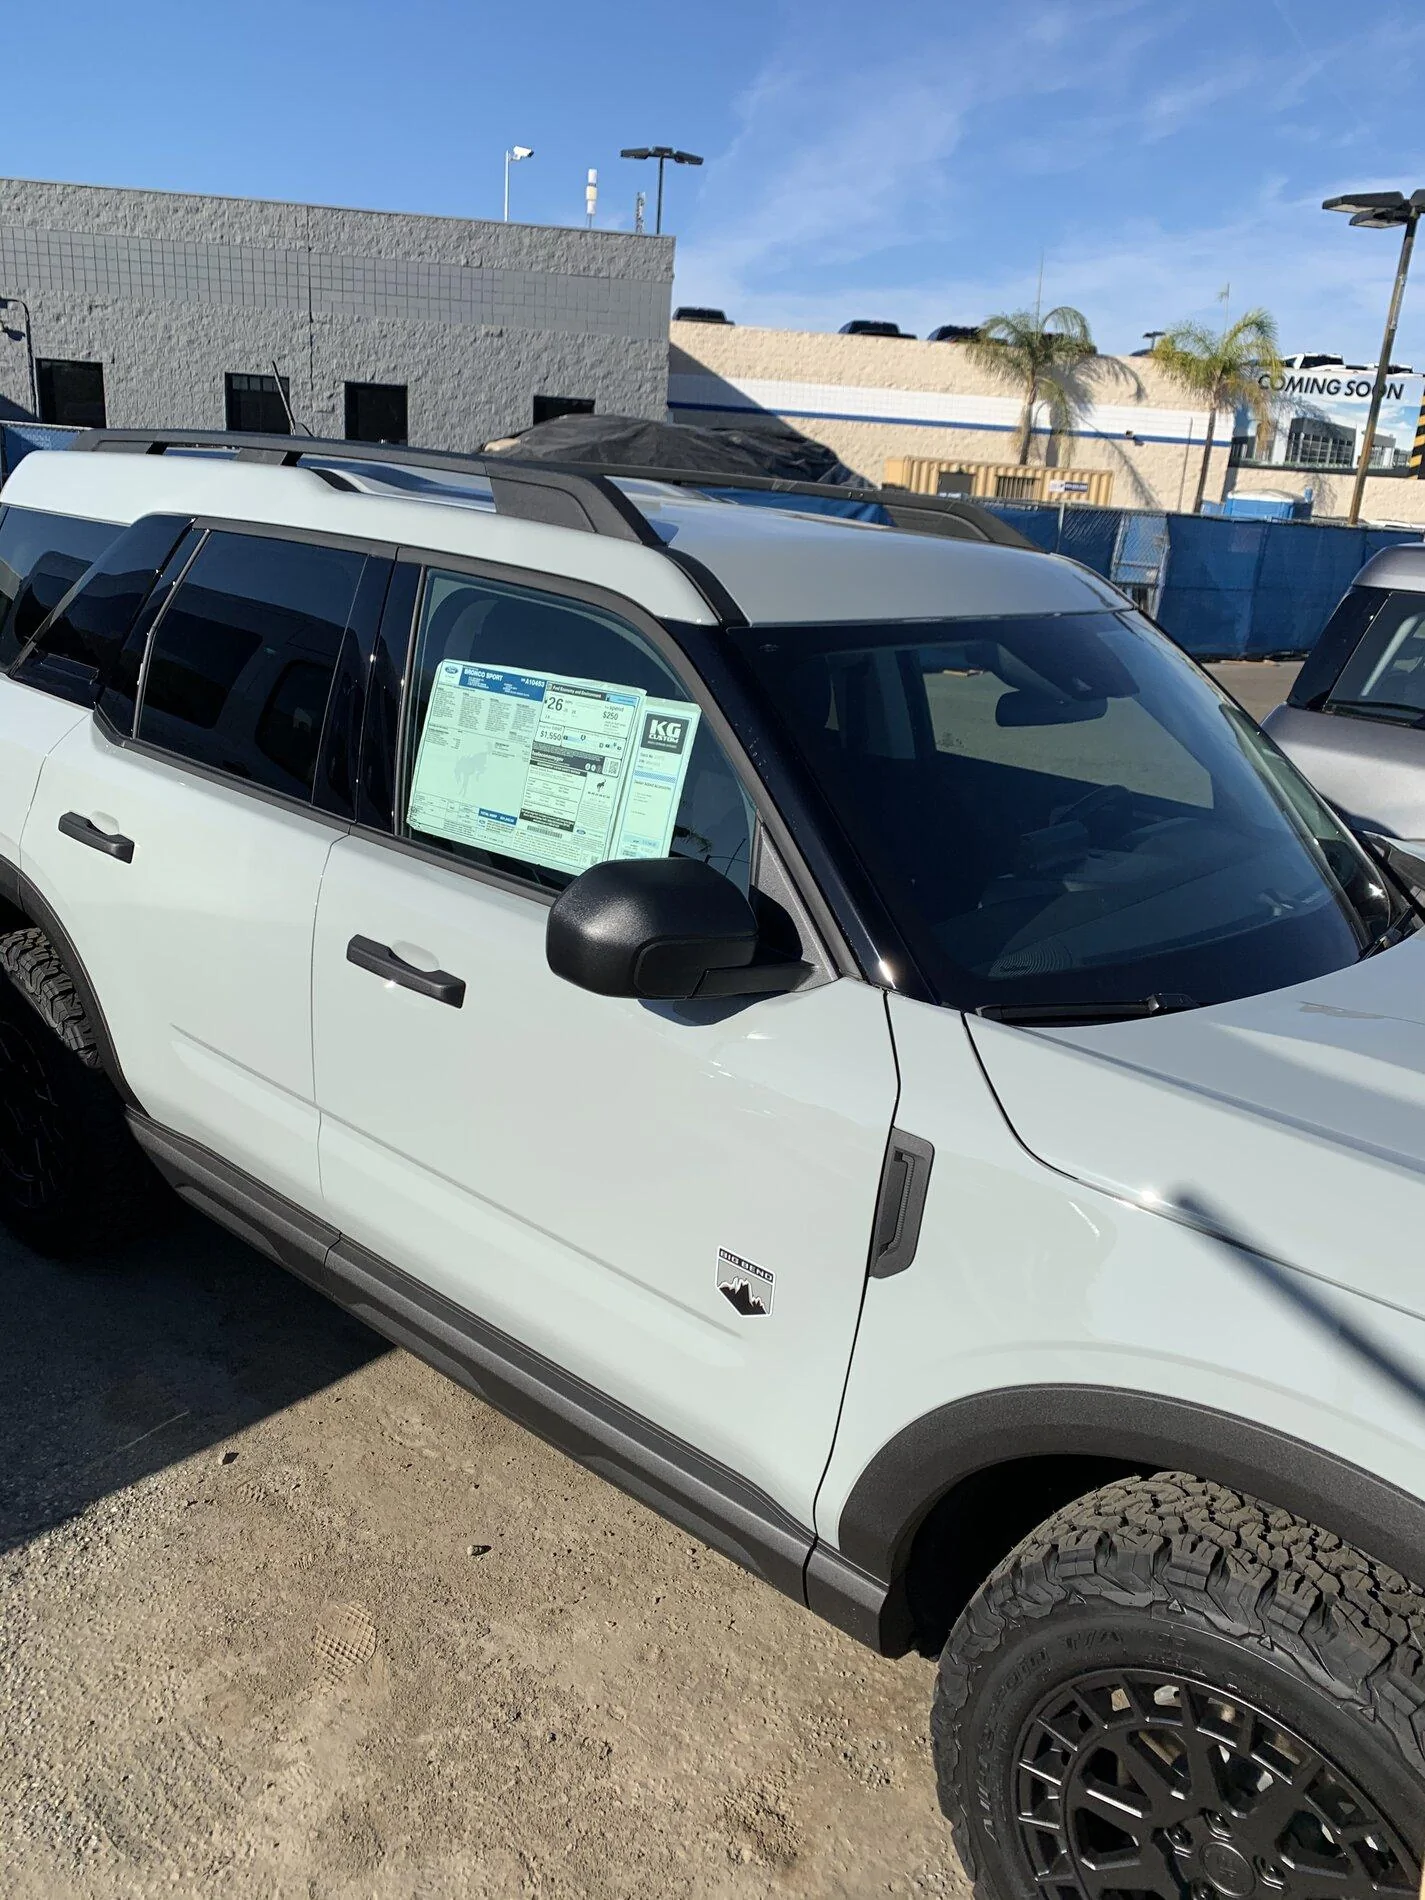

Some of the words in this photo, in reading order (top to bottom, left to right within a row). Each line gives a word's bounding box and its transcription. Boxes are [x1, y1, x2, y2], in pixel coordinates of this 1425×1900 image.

[1258, 374, 1342, 396] COMING
[1344, 380, 1405, 400] SON
[464, 668, 486, 678] BRONCO
[486, 672, 504, 682] SPORT
[547, 696, 564, 712] 26
[602, 711, 619, 721] $250
[649, 719, 682, 739] KG
[648, 734, 680, 744] CUSTOM
[720, 1250, 739, 1264] BIG
[741, 1261, 773, 1281] BEND
